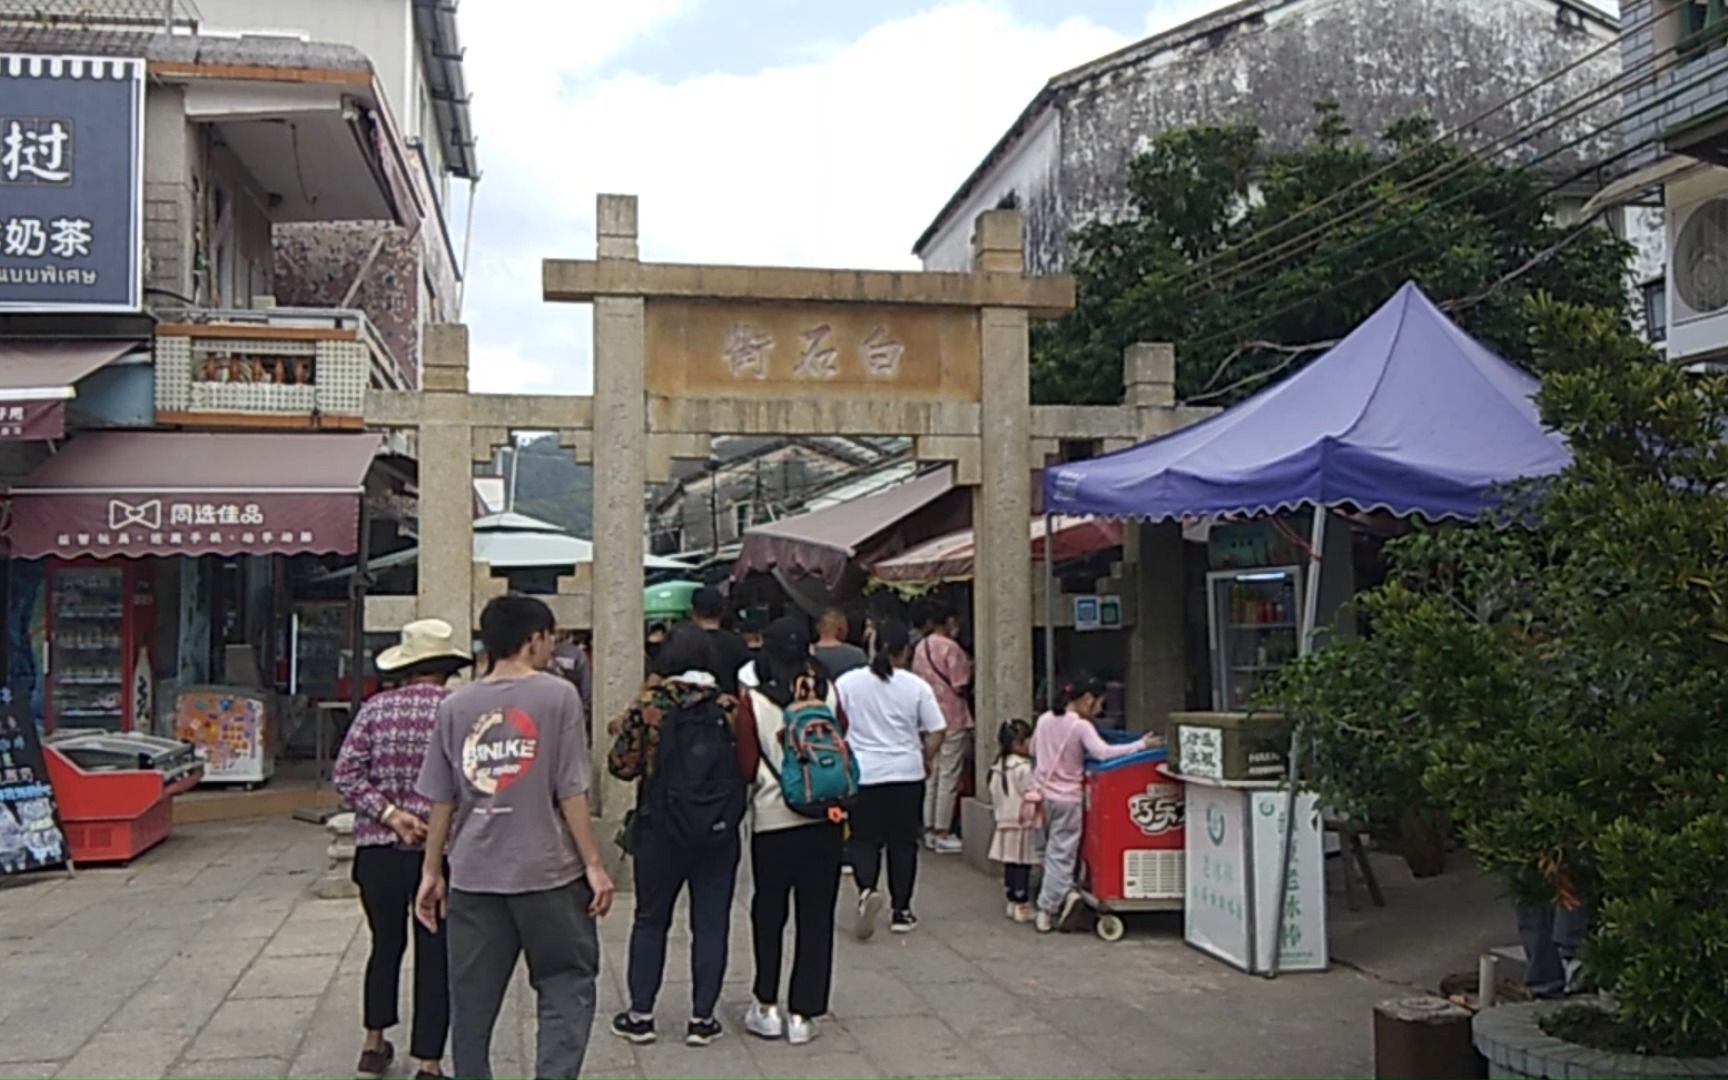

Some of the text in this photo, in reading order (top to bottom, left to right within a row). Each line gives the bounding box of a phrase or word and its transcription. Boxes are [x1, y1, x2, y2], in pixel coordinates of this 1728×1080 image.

[0, 218, 92, 257] 奶茶
[170, 503, 264, 525] 同选佳品
